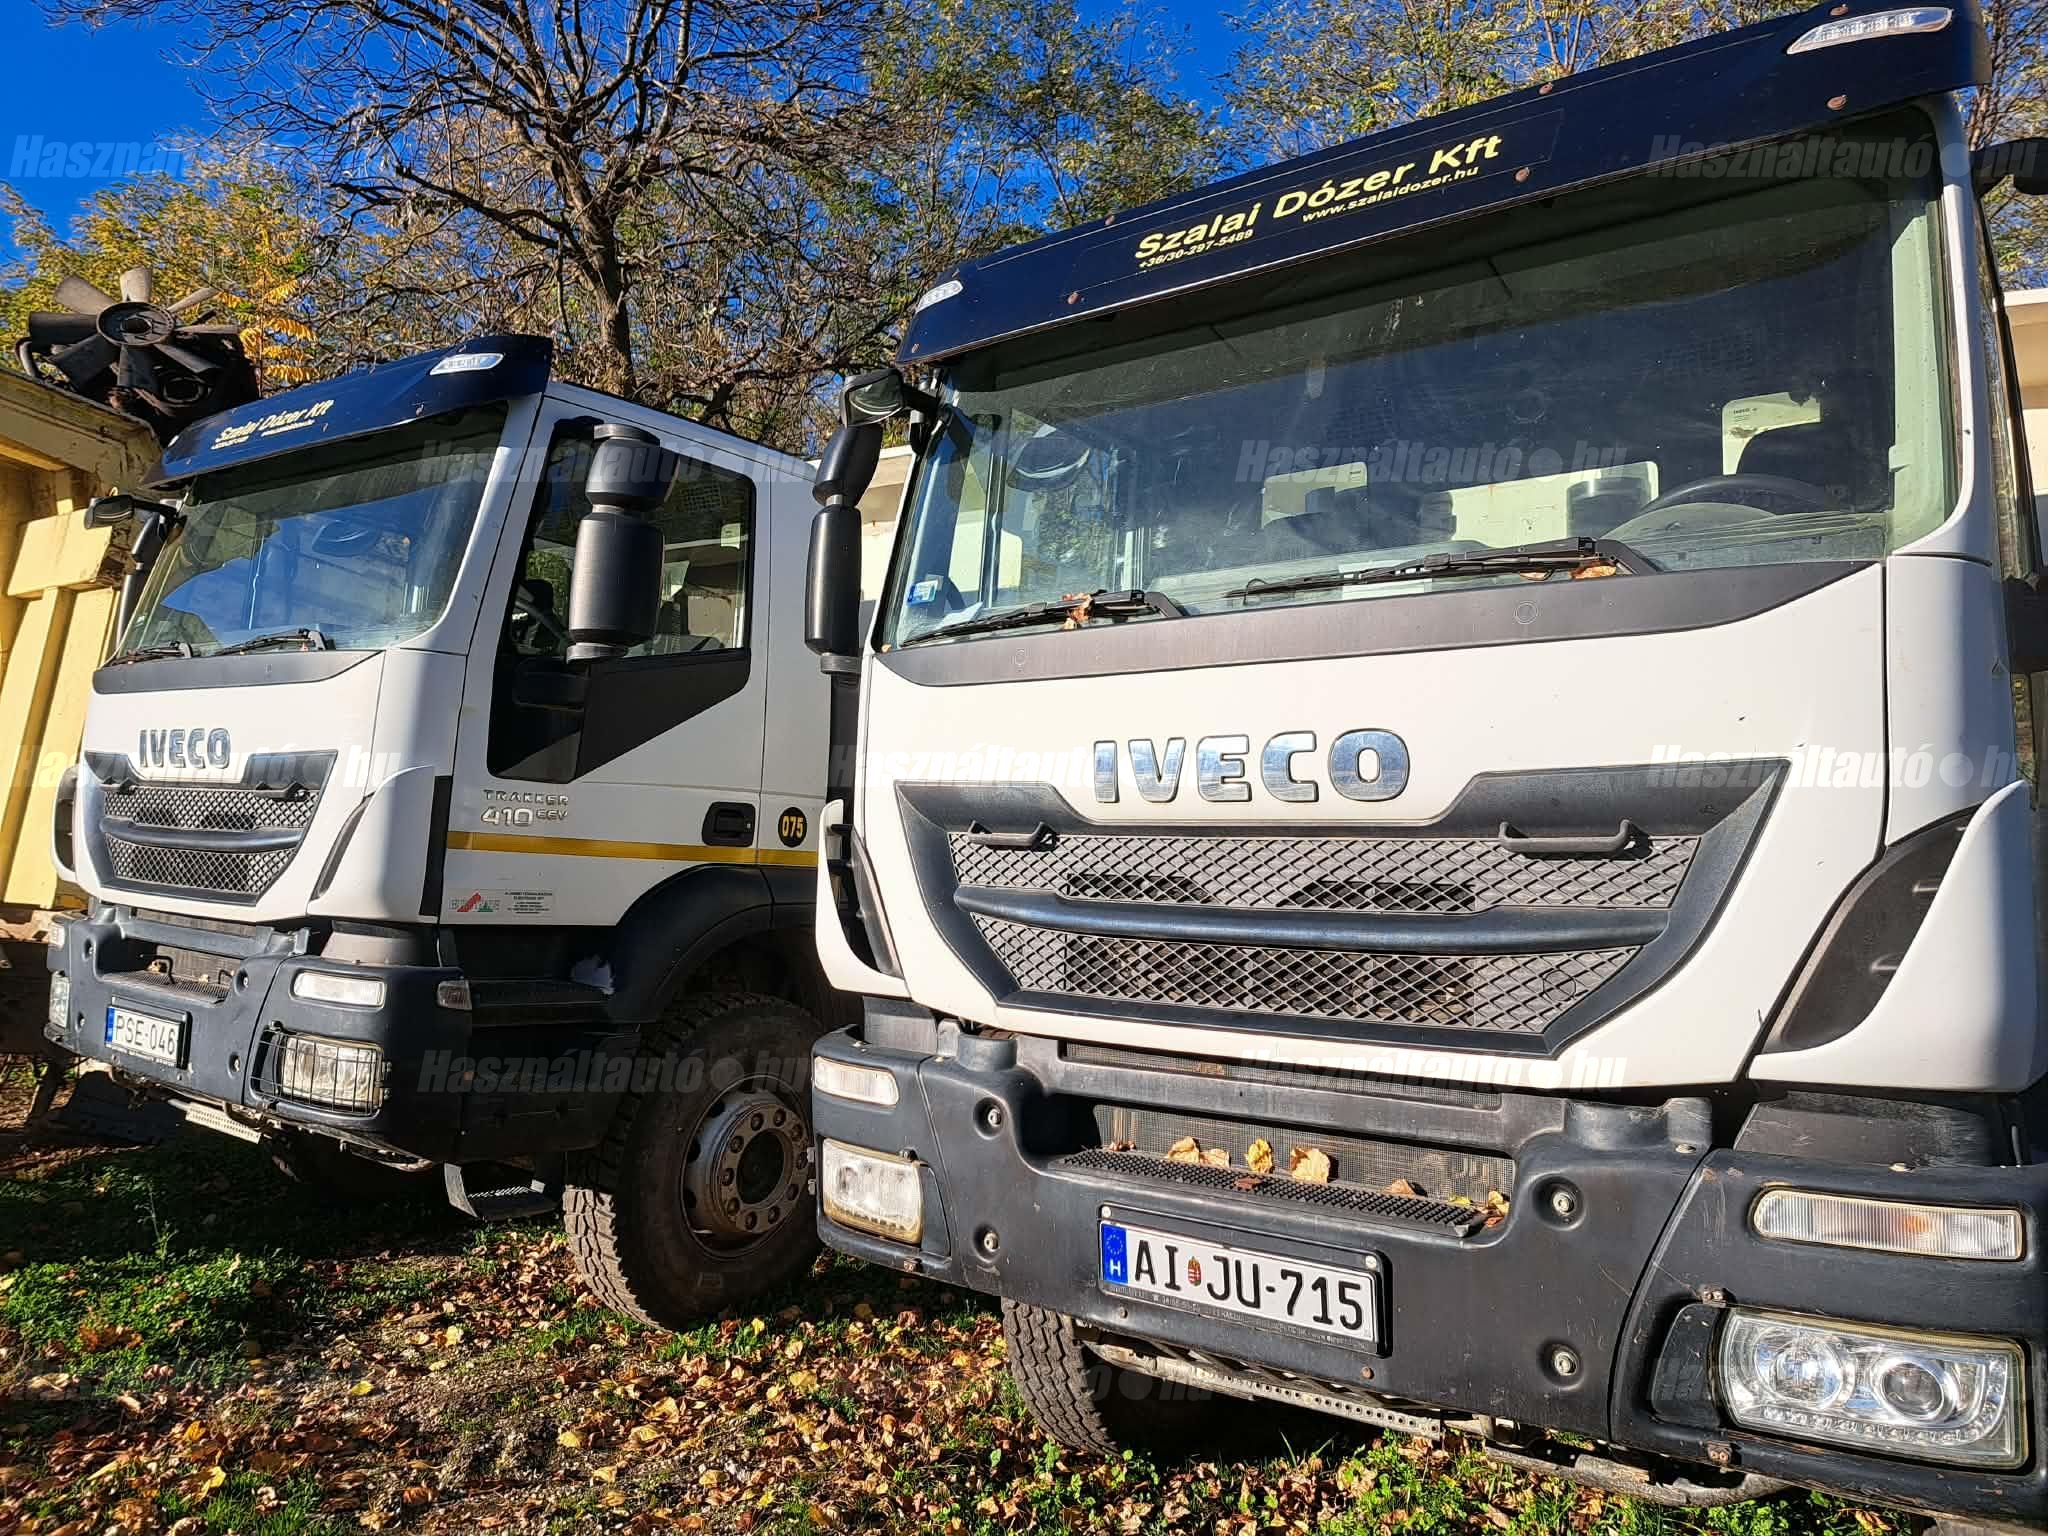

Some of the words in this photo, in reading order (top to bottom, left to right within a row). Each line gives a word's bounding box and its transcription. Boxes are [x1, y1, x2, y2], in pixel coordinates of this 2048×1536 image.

[1135, 202, 1262, 259] Szalai
[1273, 162, 1416, 220] Dózer
[1428, 135, 1503, 175] Kft
[1302, 165, 1480, 223] www.szalaidozer.hu
[138, 727, 232, 770] IVECO
[1091, 726, 1411, 804] IVECO
[480, 806, 534, 827] 410
[482, 788, 570, 806] TRAKKER
[782, 815, 804, 838] 075
[115, 1014, 176, 1056] PSE-046
[1109, 1258, 1121, 1277] H
